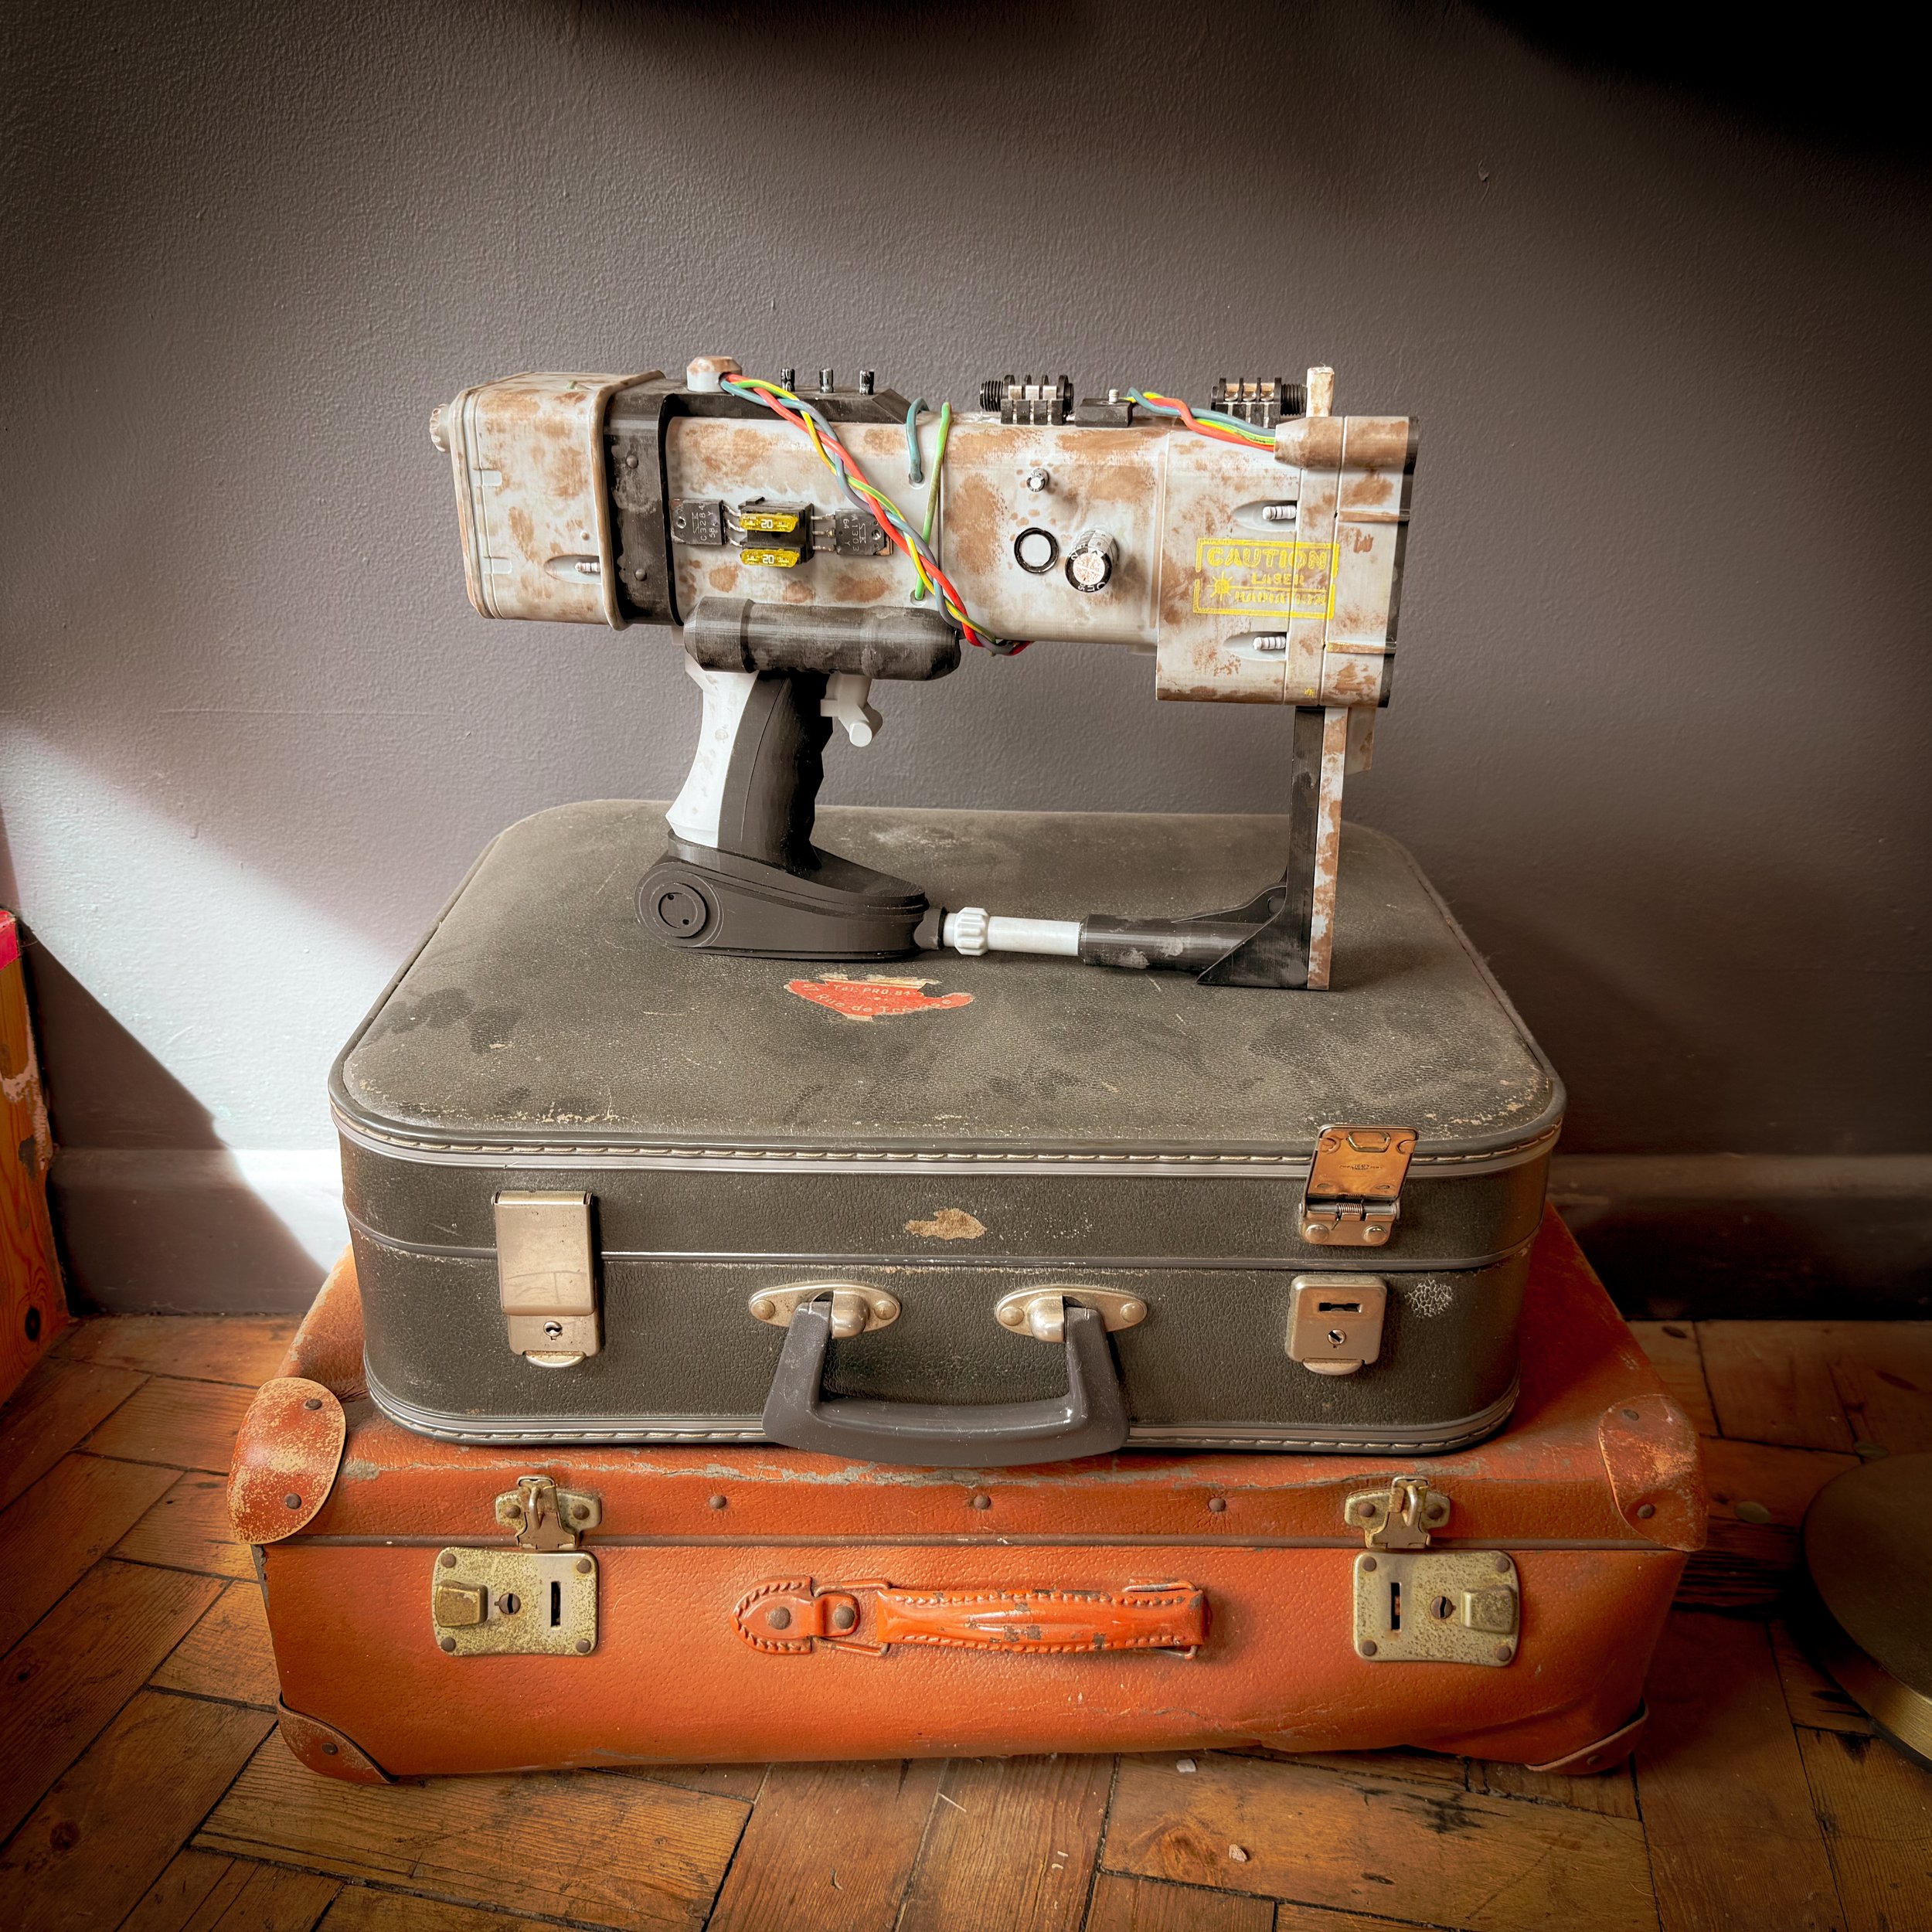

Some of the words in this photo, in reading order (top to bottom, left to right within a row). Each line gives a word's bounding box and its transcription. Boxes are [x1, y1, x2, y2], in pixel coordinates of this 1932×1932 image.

[698, 503, 707, 541] C3284
[760, 519, 774, 529] 20
[851, 514, 859, 552] A1303
[762, 554, 775, 564] 20
[1206, 546, 1328, 570] CAUTION
[1251, 572, 1304, 586] LASER
[1235, 590, 1327, 607] RADIATION
[815, 993, 845, 1007] Rue
[851, 1004, 872, 1012] de
